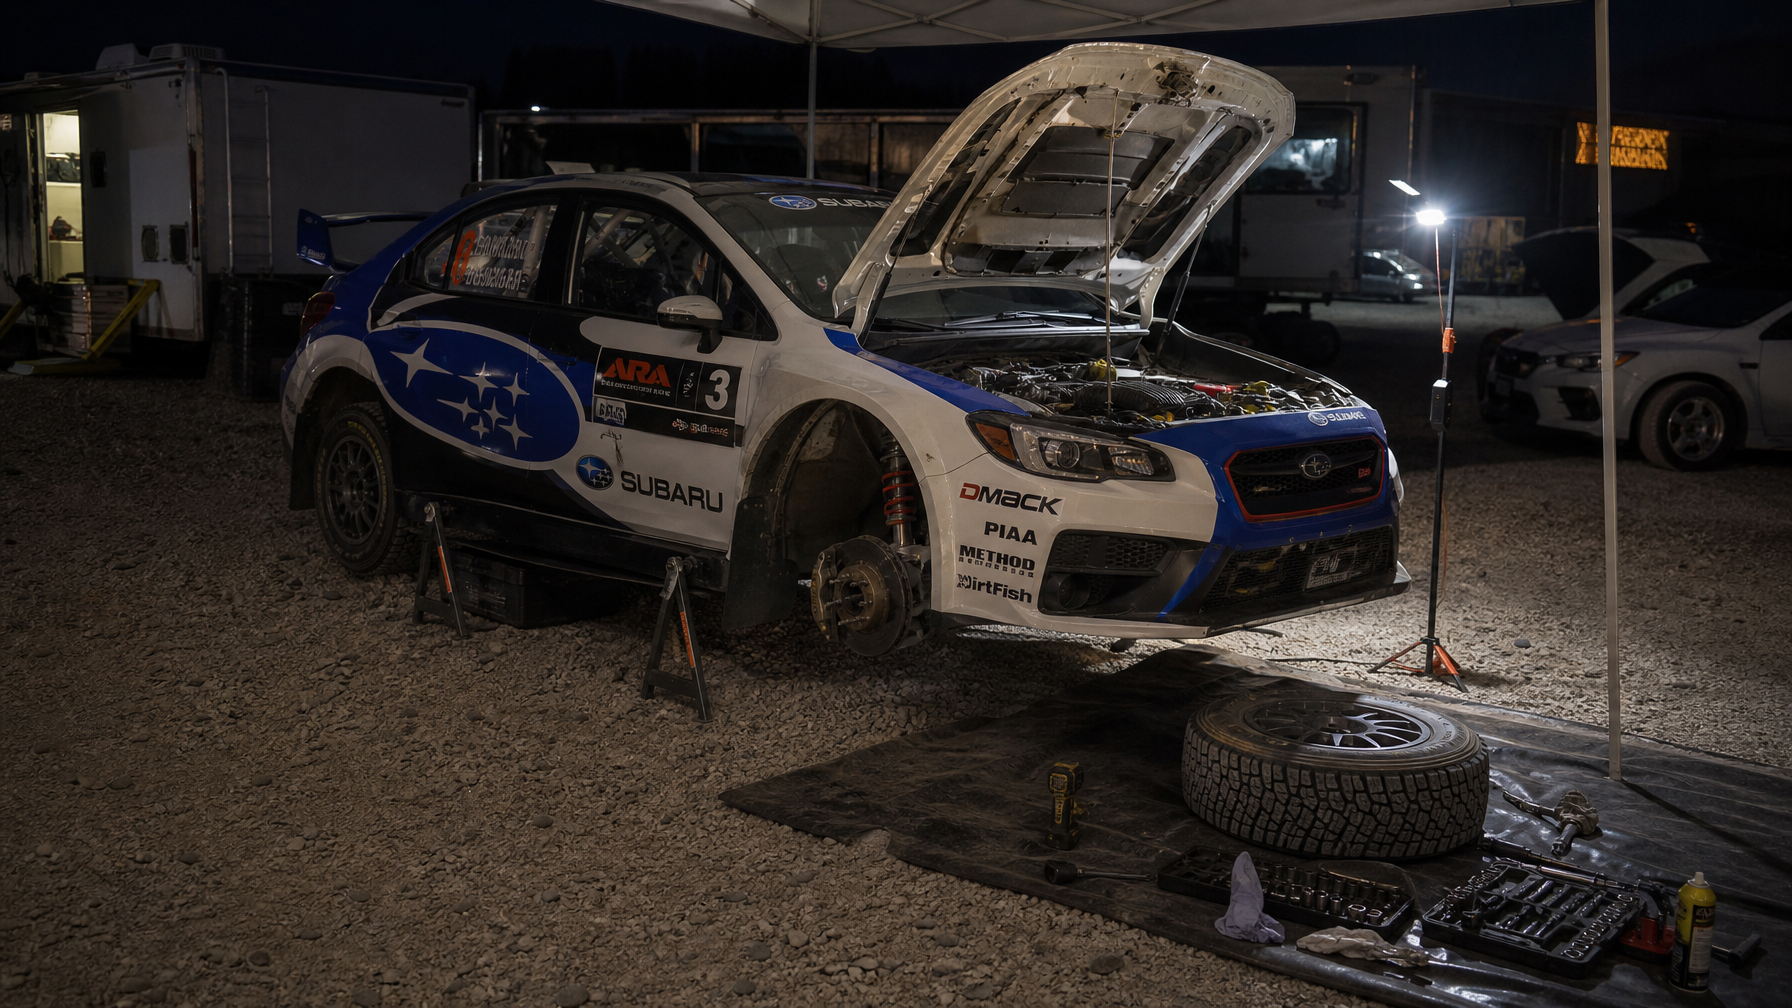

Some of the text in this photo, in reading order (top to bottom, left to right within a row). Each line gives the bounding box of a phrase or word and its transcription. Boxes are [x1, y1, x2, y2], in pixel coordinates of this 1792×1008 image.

[602, 357, 672, 388] ARA
[704, 368, 731, 411] 3
[620, 470, 723, 513] SUBARU
[984, 521, 1038, 546] PIAA
[959, 545, 1035, 571] METHOD
